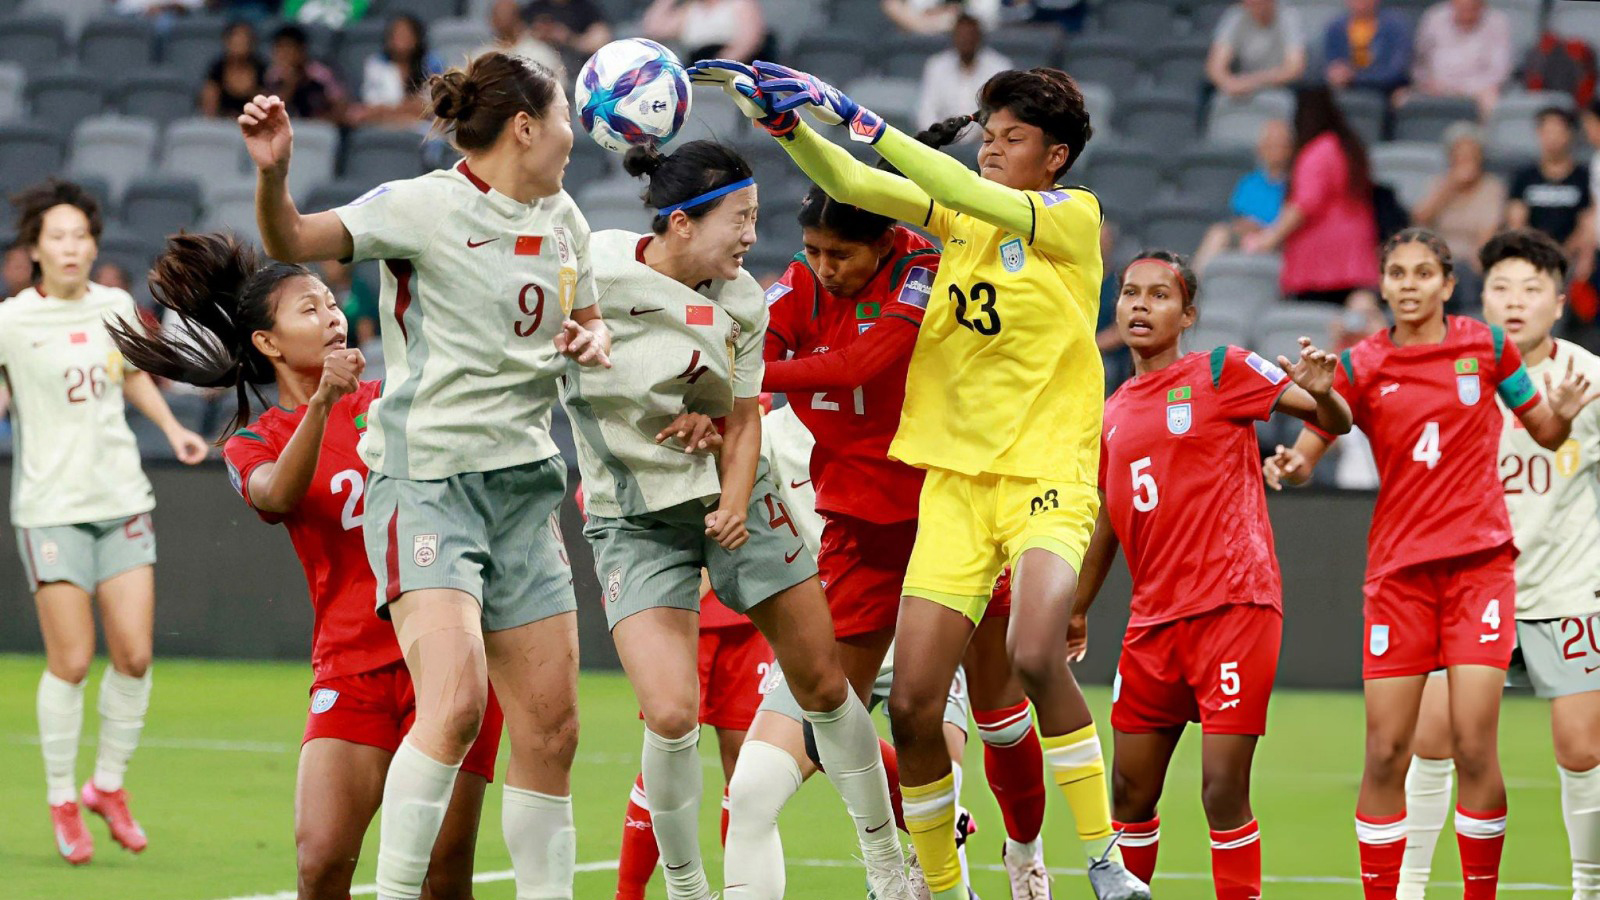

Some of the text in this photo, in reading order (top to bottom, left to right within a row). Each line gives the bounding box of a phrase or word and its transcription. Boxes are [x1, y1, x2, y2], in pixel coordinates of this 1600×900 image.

[513, 282, 545, 338] 9
[948, 281, 1002, 336] 23
[64, 364, 107, 404] 26
[1412, 421, 1442, 469] 4
[1129, 456, 1159, 512] 5
[1501, 453, 1551, 495] 20
[764, 492, 799, 538] 4
[1030, 488, 1059, 516] 23
[1481, 598, 1501, 630] 4
[1220, 661, 1241, 696] 5
